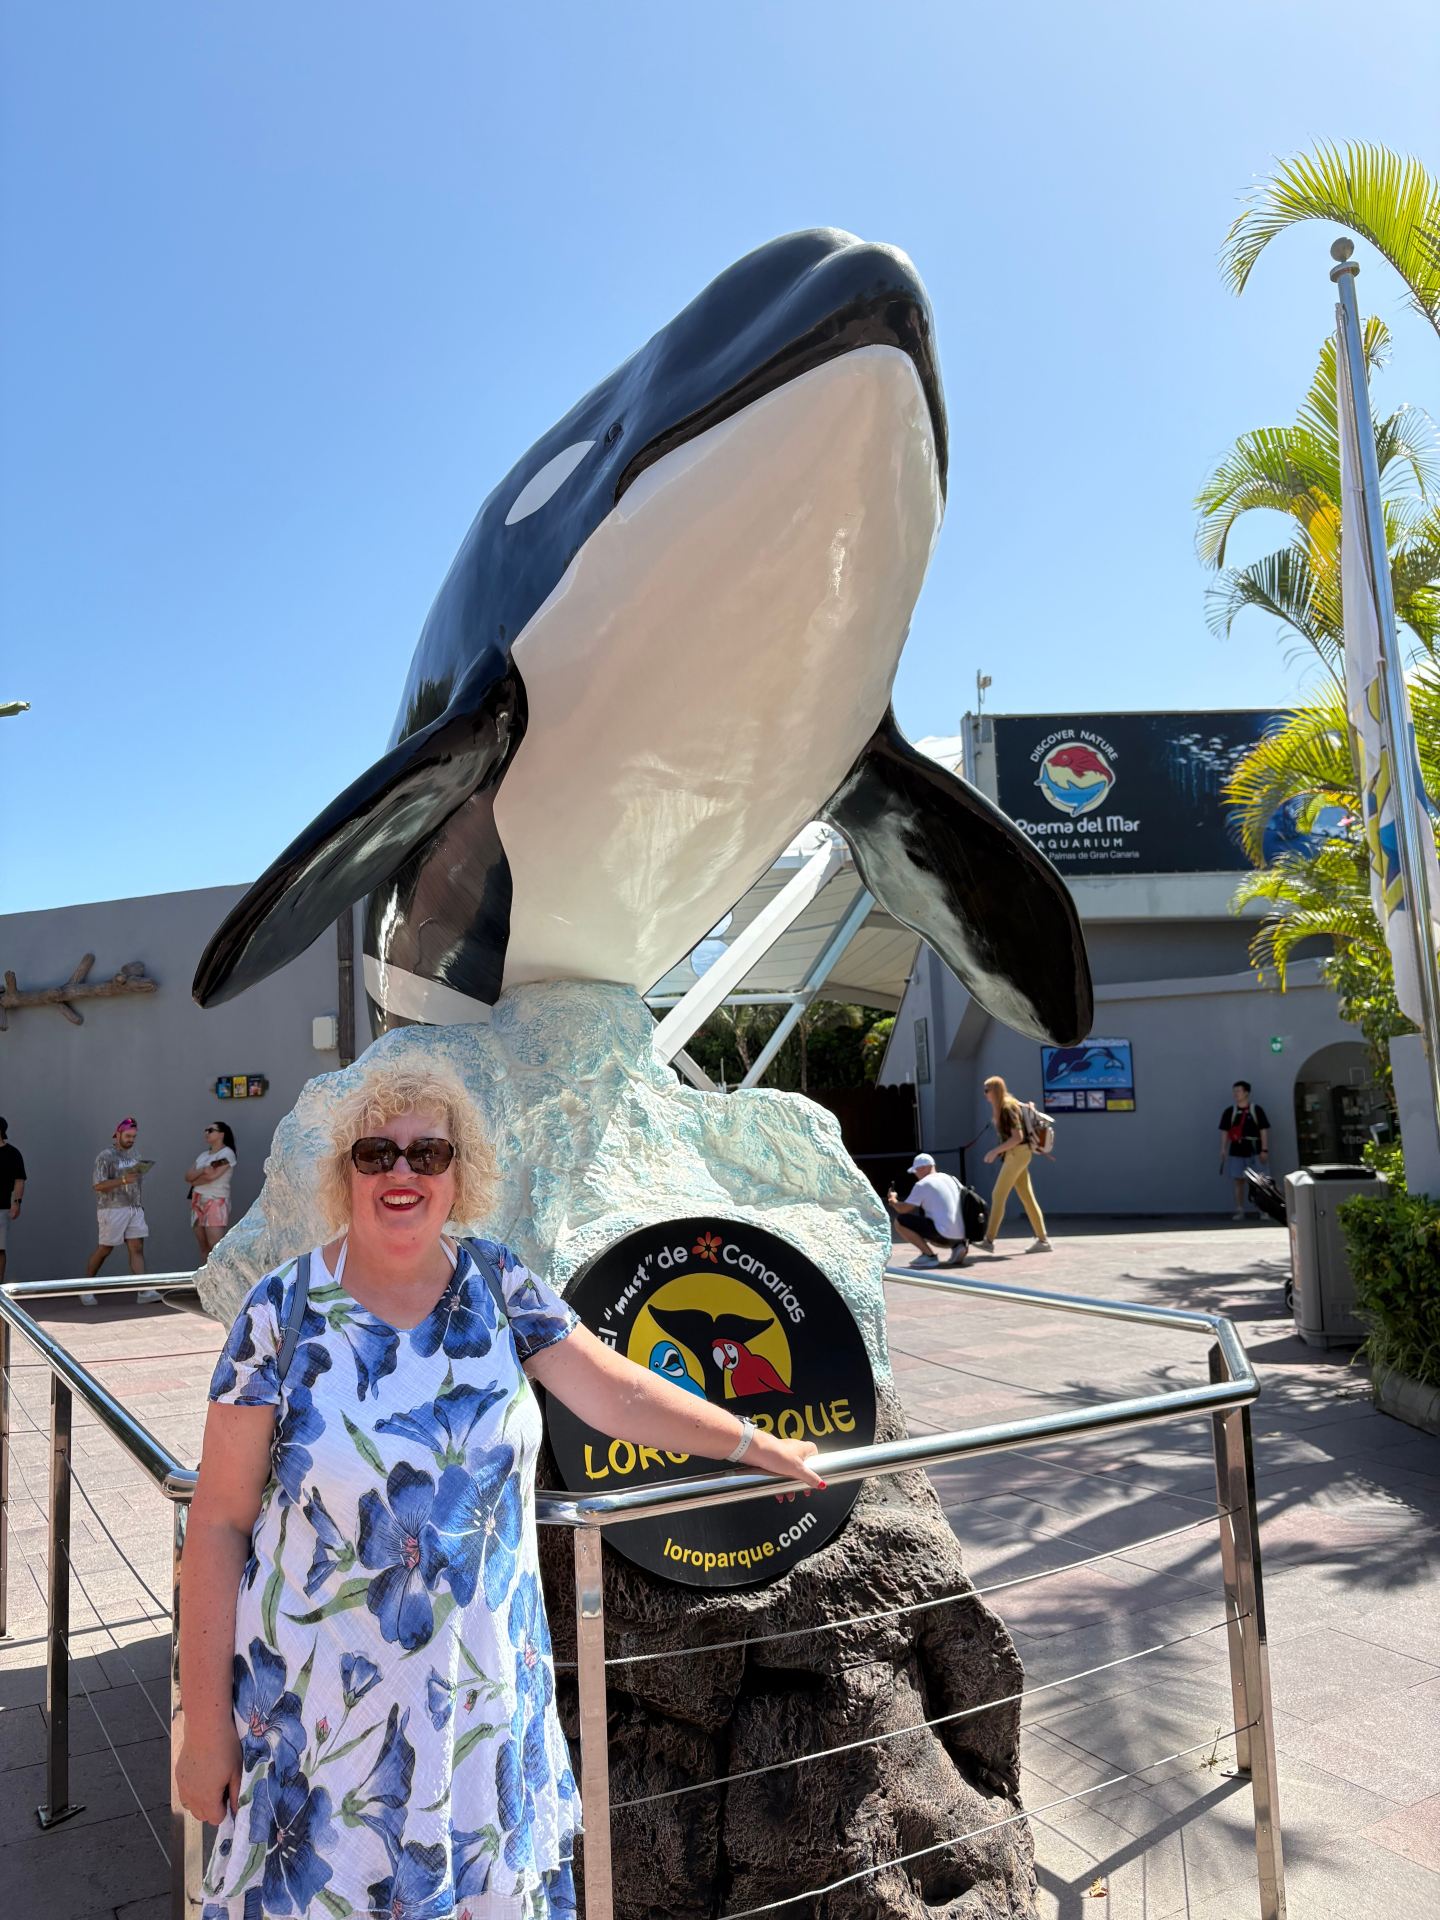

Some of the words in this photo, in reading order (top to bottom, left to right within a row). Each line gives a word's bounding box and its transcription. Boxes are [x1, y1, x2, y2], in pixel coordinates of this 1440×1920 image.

[1030, 729, 1075, 763] DISCOVER
[1080, 730, 1118, 761] NATURE
[1016, 819, 1074, 835] Poema
[1077, 817, 1103, 833] del
[1106, 815, 1140, 832] Mar
[1037, 838, 1123, 849] AQUARIUM
[1049, 852, 1077, 860] Palmas
[1080, 851, 1088, 859] de
[1090, 850, 1109, 859] Gran
[1110, 849, 1140, 858] Canaria
[657, 1246, 688, 1269] de
[722, 1244, 805, 1323] Canarias
[751, 1398, 856, 1441] RQUE
[663, 1512, 818, 1572] loroparque.com
